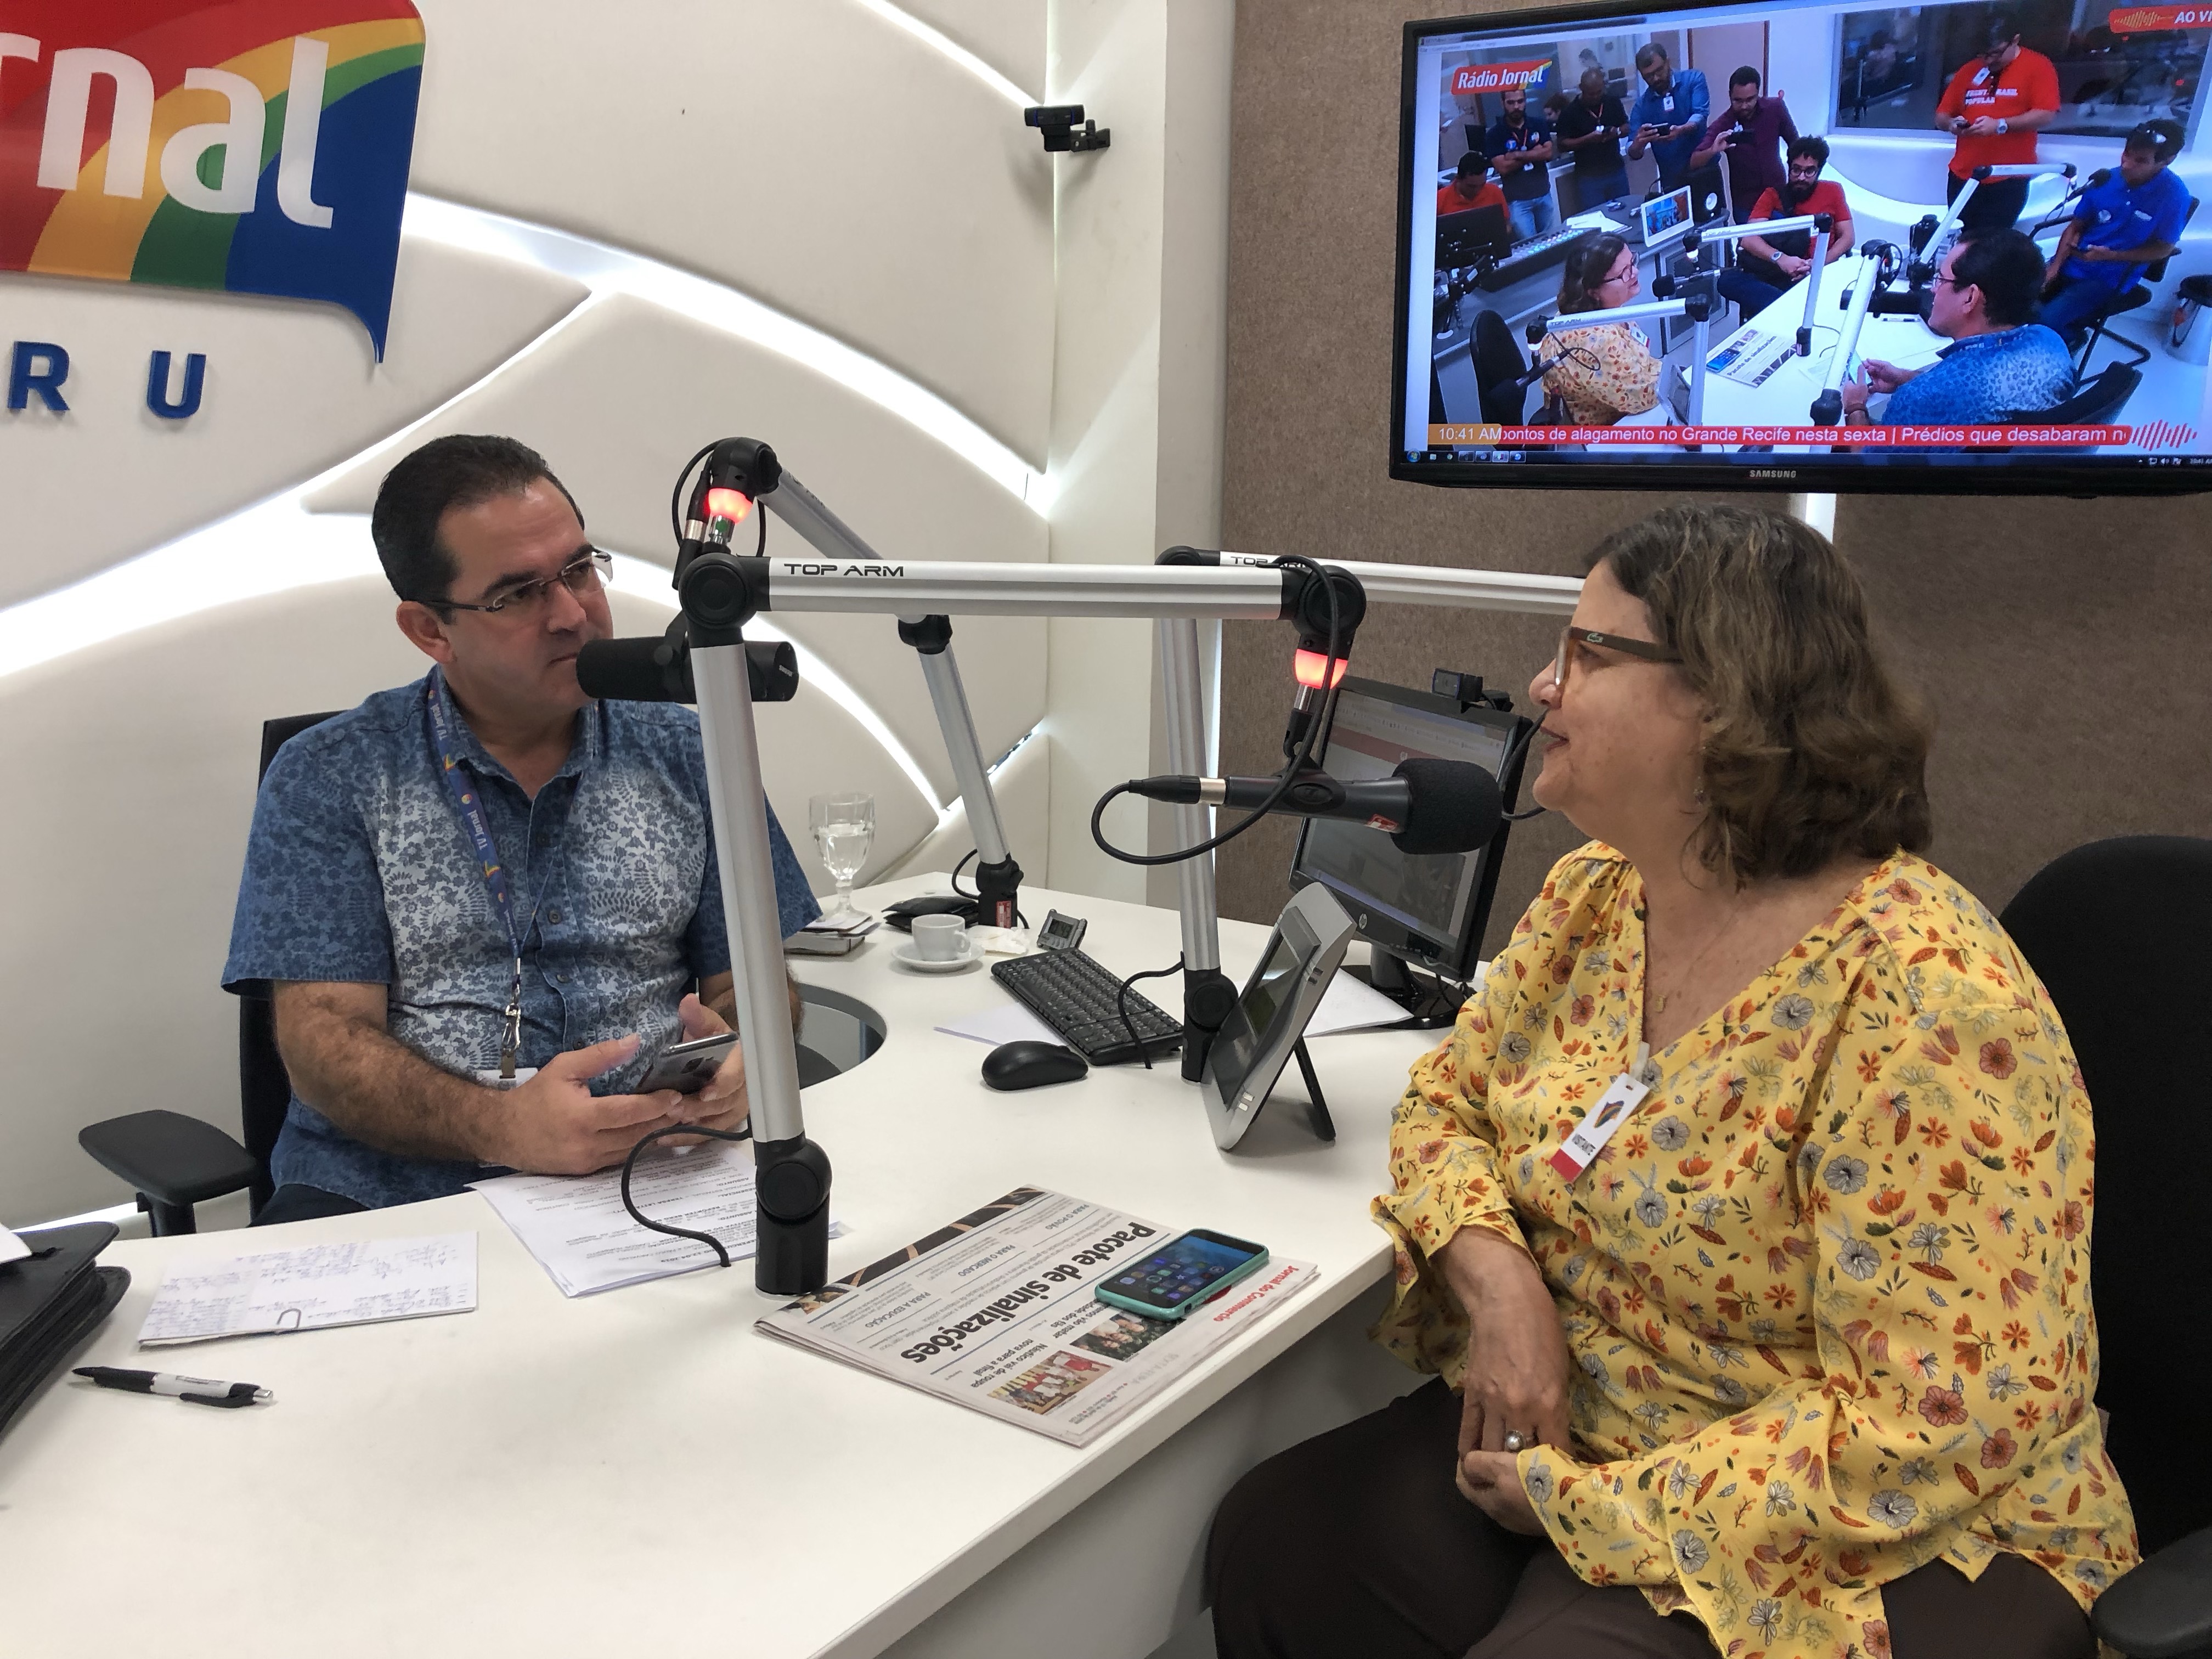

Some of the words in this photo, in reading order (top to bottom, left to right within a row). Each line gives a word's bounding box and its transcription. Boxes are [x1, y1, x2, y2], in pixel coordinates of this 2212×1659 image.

[2174, 10, 2195, 24] AO
[1458, 70, 1498, 89] Rádio
[1499, 64, 1544, 86] Jornal
[1439, 428, 1474, 440] 10:41
[1479, 428, 1502, 439] AM
[1550, 428, 1568, 440] de
[1571, 428, 1655, 443] alagamento
[1659, 431, 1678, 441] no
[1681, 428, 1737, 441] Grande
[1743, 427, 1791, 441] Recife
[1796, 429, 1838, 442] nesta
[1843, 429, 1886, 442] sexta
[1901, 427, 1964, 442] Prédios
[1970, 430, 2002, 445] que
[2008, 428, 2107, 442] desabaram
[2112, 430, 2126, 441] n
[1750, 470, 1797, 478] SAMSUNG
[784, 563, 838, 575] TOP
[843, 565, 904, 577] ARM
[467, 809, 484, 836] Jornal
[477, 837, 488, 851] TV
[995, 1245, 1015, 1255] PARA
[1071, 1222, 1156, 1265] Pacote
[958, 1257, 992, 1276] MERCADO
[1042, 1265, 1082, 1282] de
[1269, 1266, 1299, 1285] Jornal
[909, 1292, 931, 1303] PARA
[901, 1280, 1050, 1363] sinalizações
[1014, 1339, 1034, 1350] nova
[996, 1350, 1016, 1361] para
[1016, 1344, 1048, 1361] Náutico
[973, 1365, 995, 1376] final
